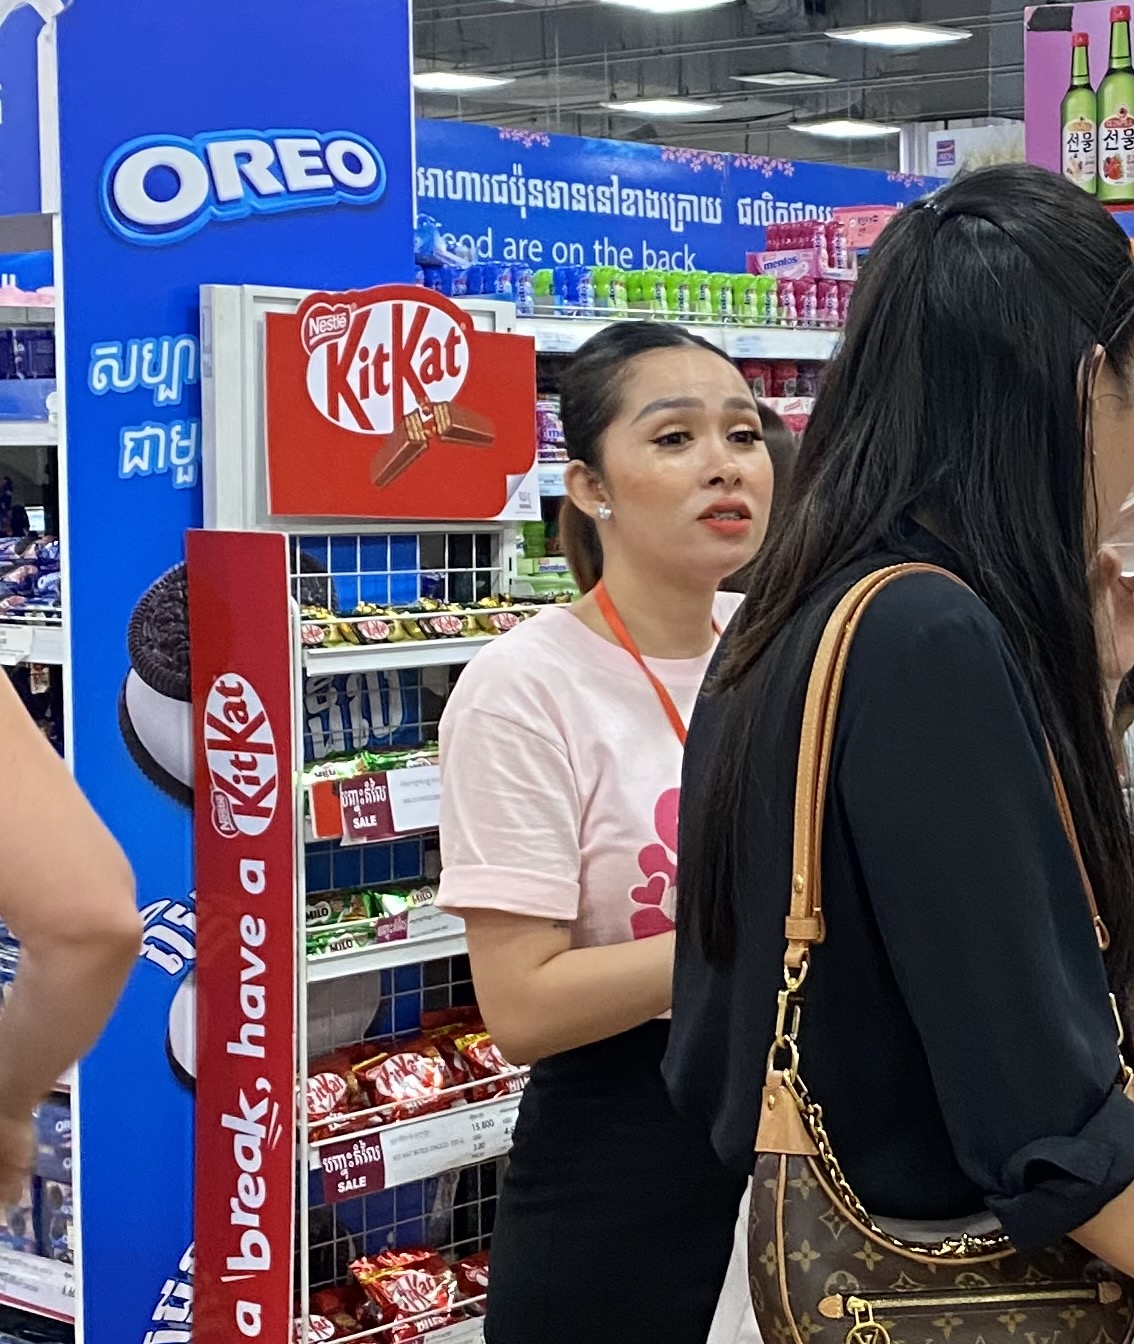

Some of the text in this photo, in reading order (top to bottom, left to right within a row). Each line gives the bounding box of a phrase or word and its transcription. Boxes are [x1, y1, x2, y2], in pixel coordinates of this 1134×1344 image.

[113, 138, 377, 225] OREO
[503, 235, 543, 262] are
[552, 241, 584, 266] on
[593, 236, 633, 267] the
[642, 239, 697, 272] back
[763, 256, 798, 270] mentos
[206, 680, 274, 818] KitKat
[353, 815, 377, 829] SALE
[239, 860, 265, 894] a
[406, 890, 433, 904] MILO
[306, 908, 328, 920] MILO
[329, 939, 353, 953] MILO
[226, 914, 265, 1058] have
[337, 1177, 367, 1194] SALE
[235, 1304, 261, 1340] a
